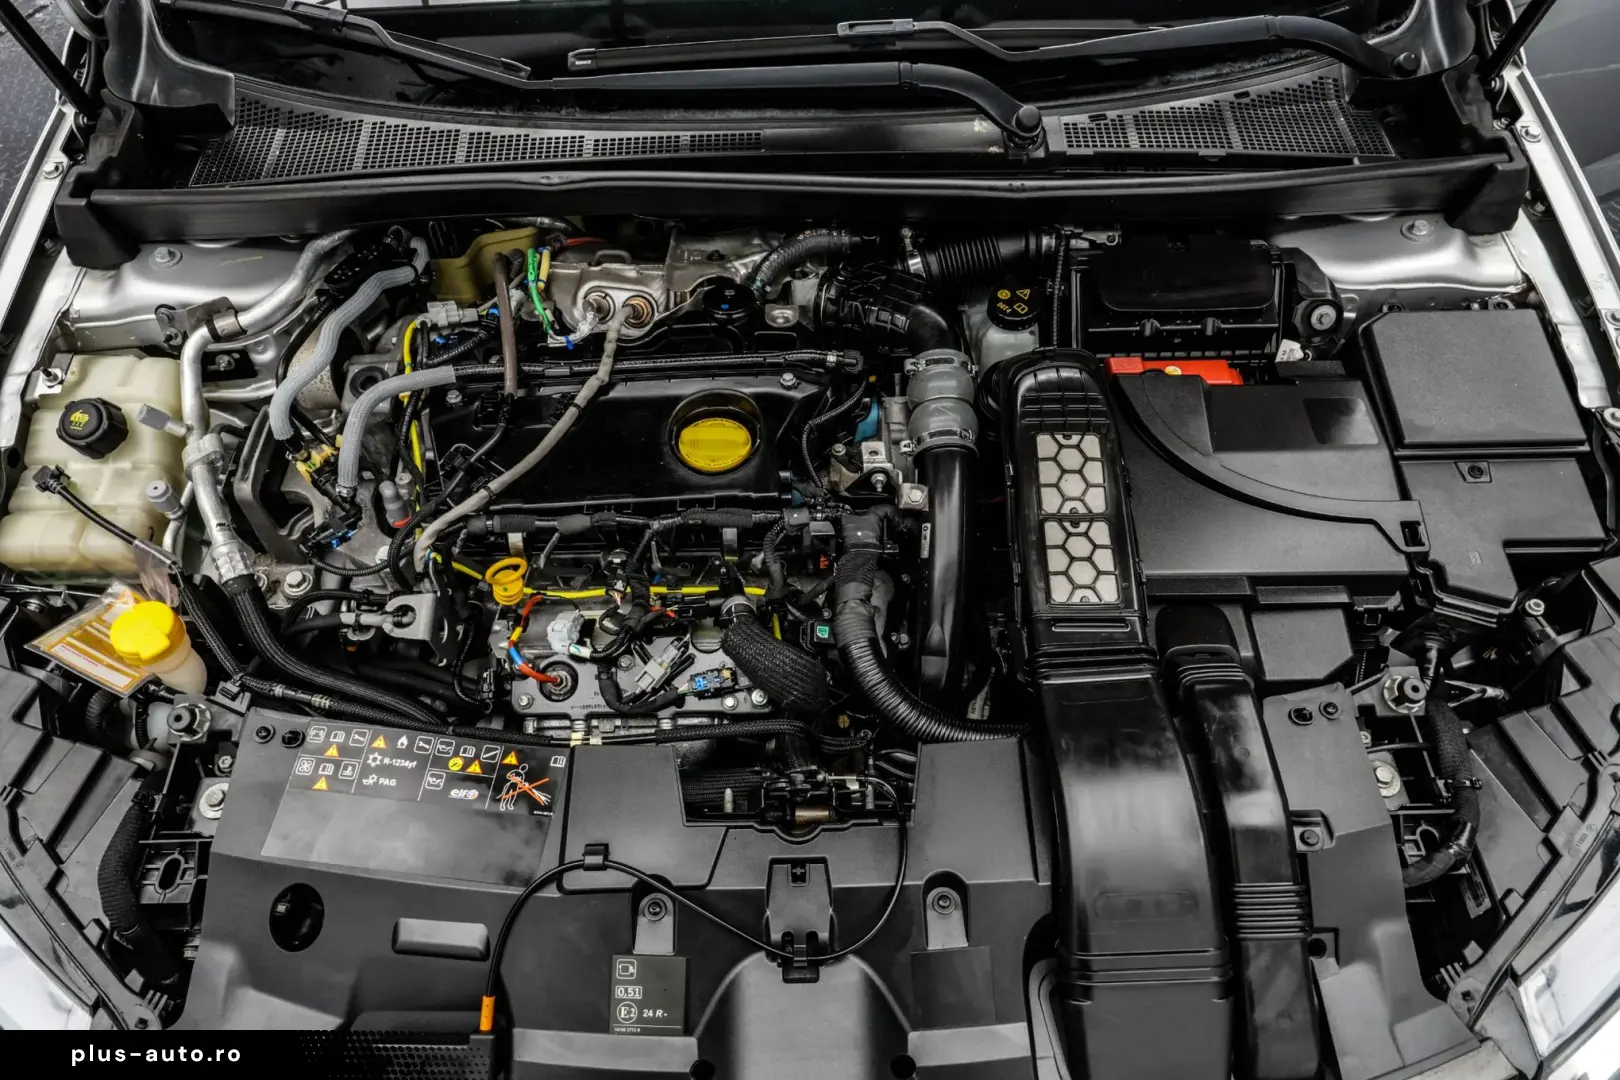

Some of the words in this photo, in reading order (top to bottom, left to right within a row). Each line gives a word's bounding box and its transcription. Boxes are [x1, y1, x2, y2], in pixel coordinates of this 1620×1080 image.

[383, 757, 417, 769] R-1234yf
[378, 778, 397, 787] PAG
[449, 788, 473, 798] elf
[617, 987, 640, 997] 0,51
[642, 1009, 654, 1018] 24
